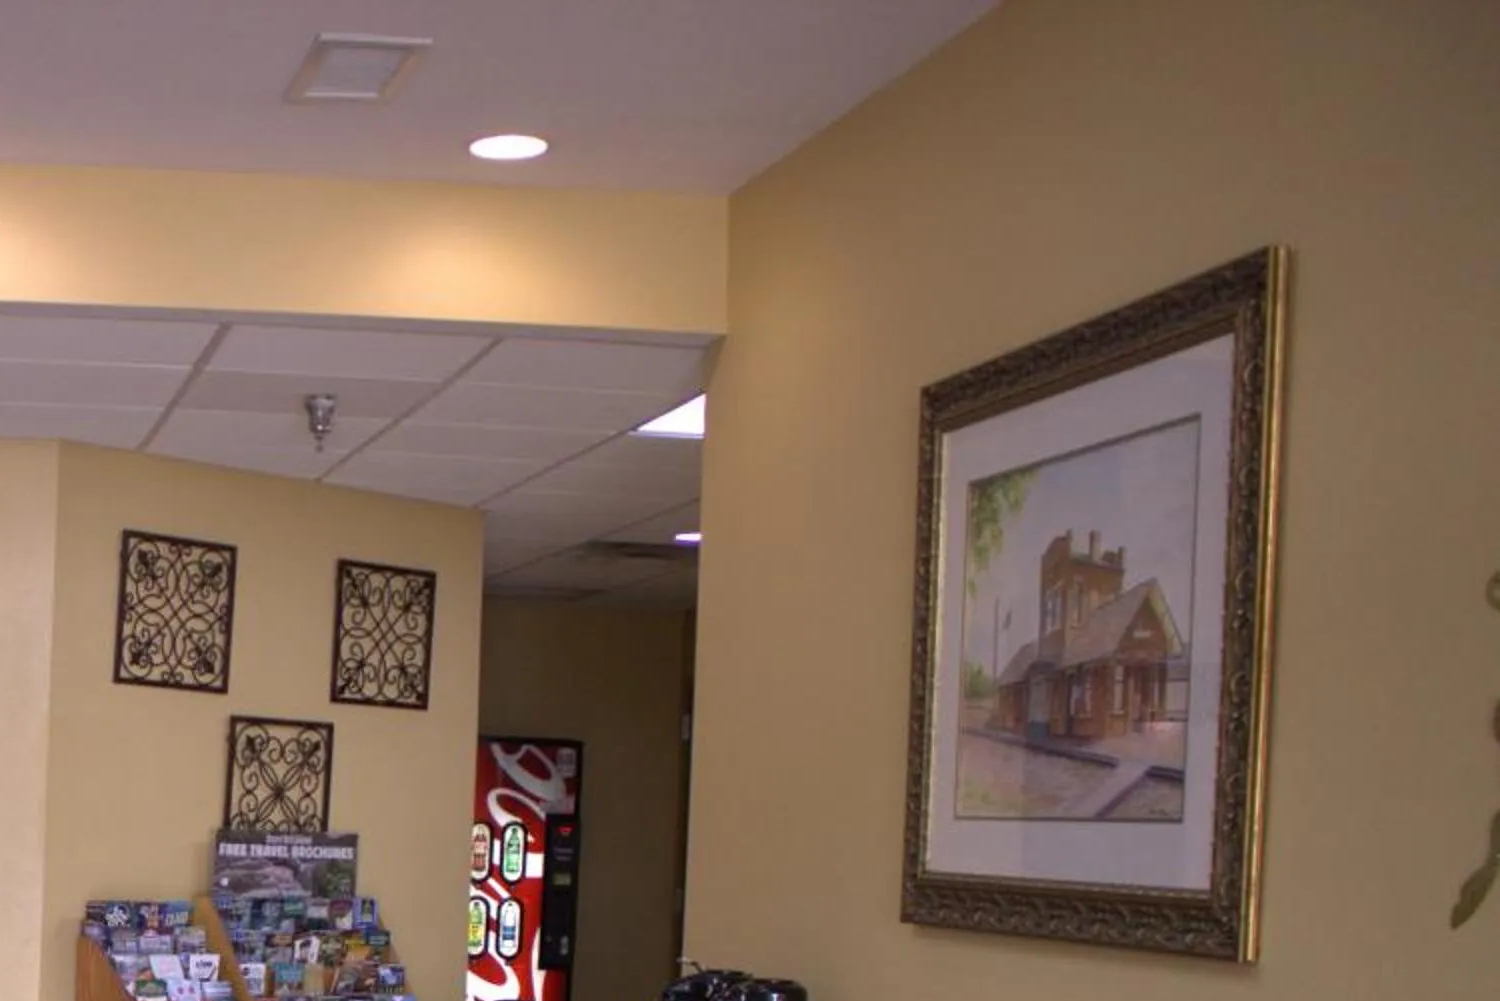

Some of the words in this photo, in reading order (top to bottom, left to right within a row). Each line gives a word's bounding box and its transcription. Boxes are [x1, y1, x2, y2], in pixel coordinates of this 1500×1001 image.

[218, 842, 248, 857] FREE
[250, 843, 289, 858] TRAVEL
[291, 845, 354, 860] BROCHURES
